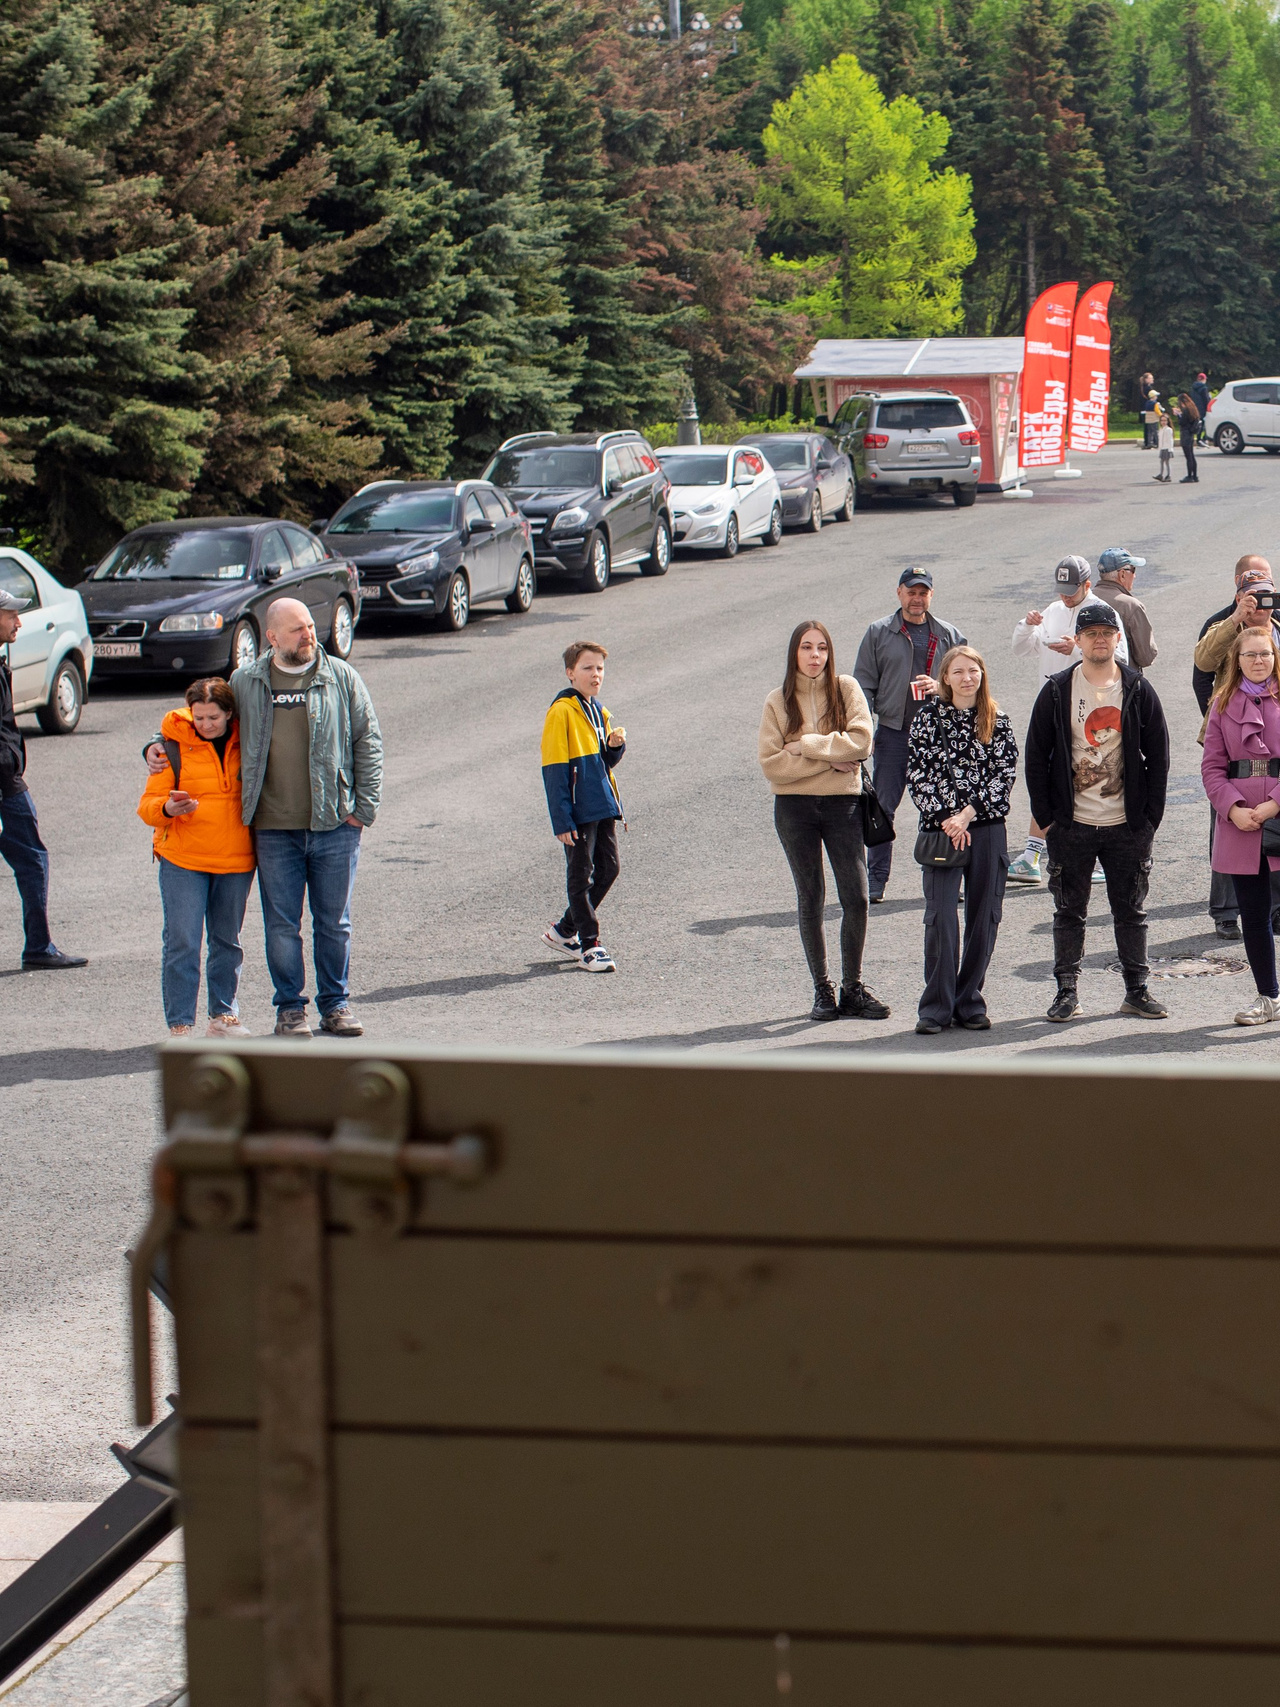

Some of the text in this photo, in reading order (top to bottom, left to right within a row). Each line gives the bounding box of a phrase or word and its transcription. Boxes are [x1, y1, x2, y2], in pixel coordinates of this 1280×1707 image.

[1040, 379, 1068, 465] ПОБЕДЫ
[1070, 398, 1091, 451] ПАРК
[1087, 370, 1109, 452] ПОБЕДЫ
[1022, 411, 1044, 466] ПАРК
[93, 645, 125, 655] 280УТ
[1078, 698, 1086, 723] おいしい
